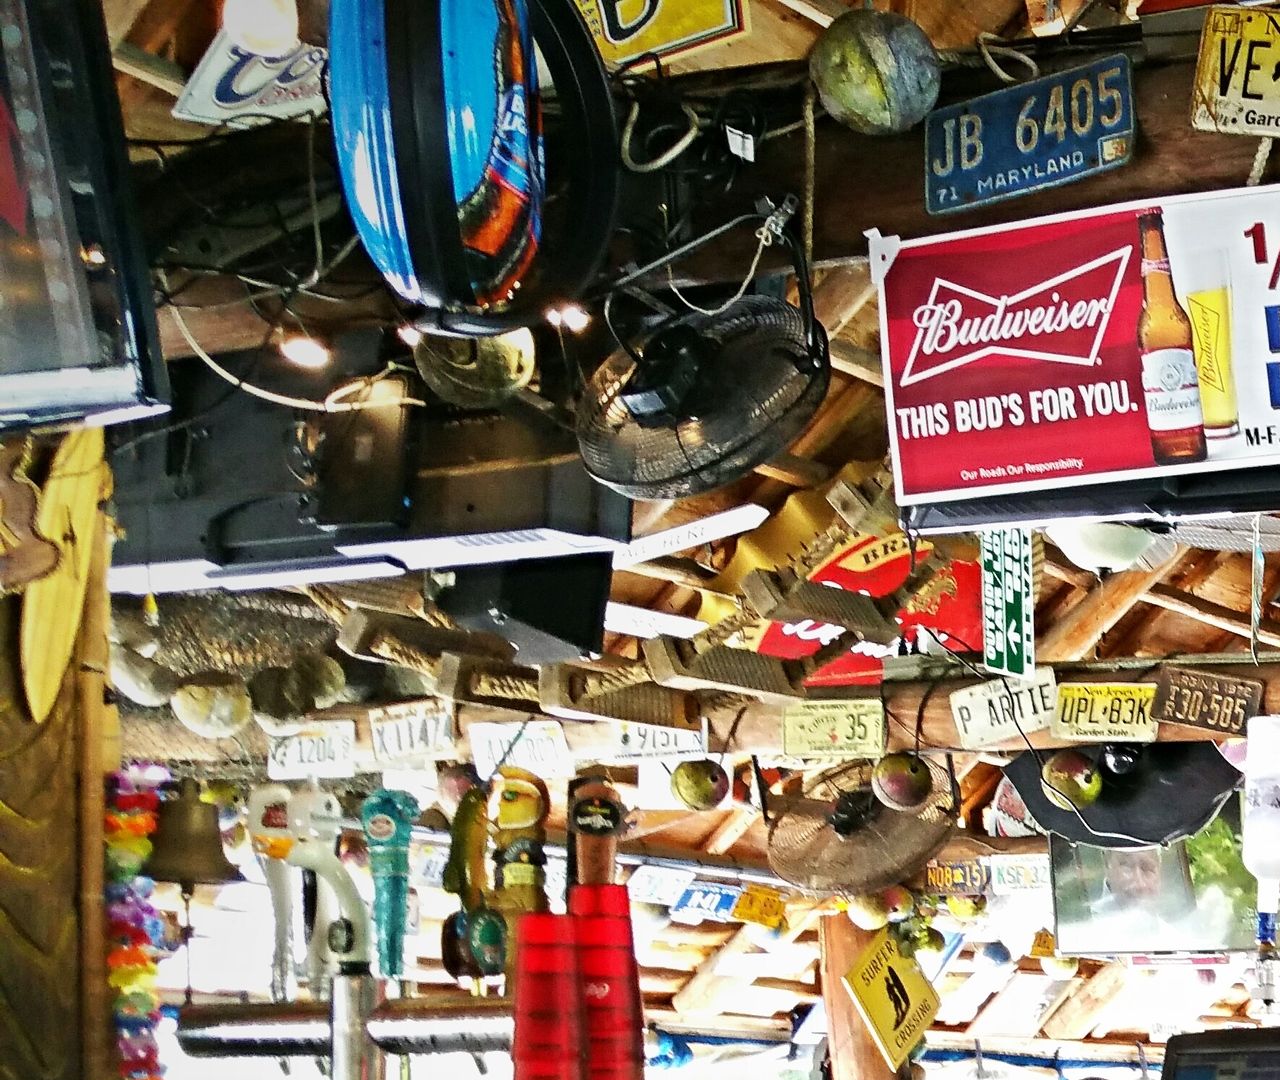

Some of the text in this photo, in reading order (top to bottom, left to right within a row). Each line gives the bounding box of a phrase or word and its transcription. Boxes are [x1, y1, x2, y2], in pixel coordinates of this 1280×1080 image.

[933, 67, 1122, 178] JB 6405
[978, 150, 1084, 192] MARYLAND
[913, 292, 1110, 355] Budweiser
[897, 379, 1138, 440] THIS BUD'S FOR YOU.
[984, 572, 997, 660] OUTSIDE
[959, 683, 1054, 735] P ARTIE
[1083, 687, 1134, 699] New Jersey
[846, 713, 867, 741] 35
[1075, 728, 1129, 738] Garden State
[861, 940, 896, 987] SURFER
[896, 998, 932, 1049] CROSSING
